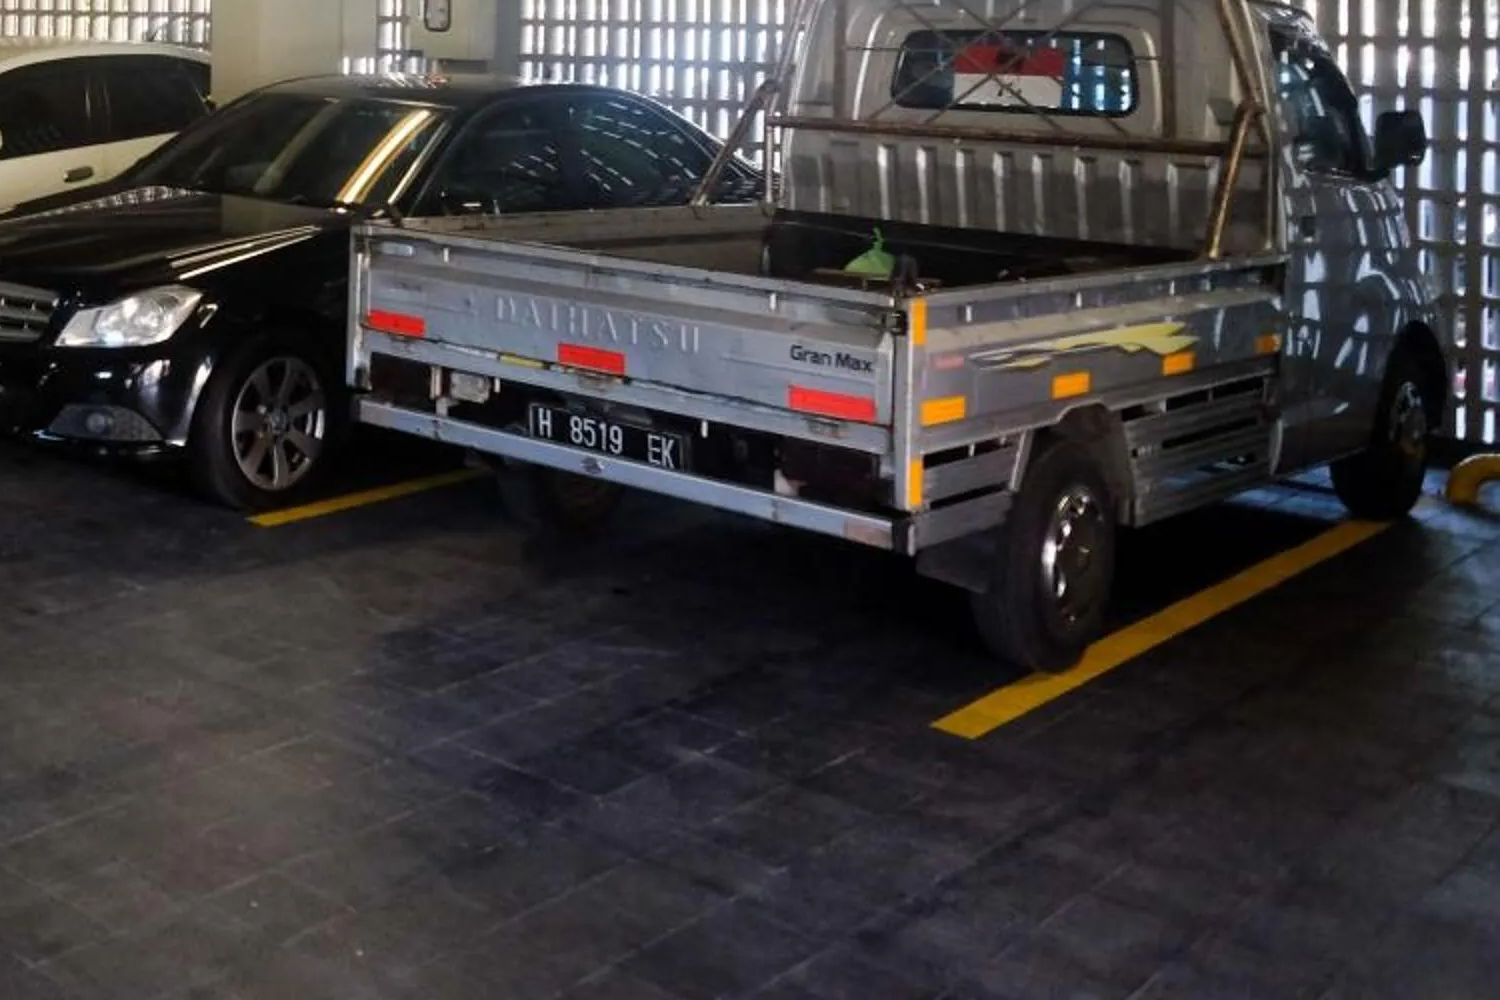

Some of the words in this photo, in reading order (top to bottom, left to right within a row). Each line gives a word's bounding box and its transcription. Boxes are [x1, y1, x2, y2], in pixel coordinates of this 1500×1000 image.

[790, 344, 832, 367] Gran
[835, 351, 873, 373] Max
[538, 407, 552, 437] H
[569, 415, 623, 454] 8519
[647, 433, 675, 469] EK
